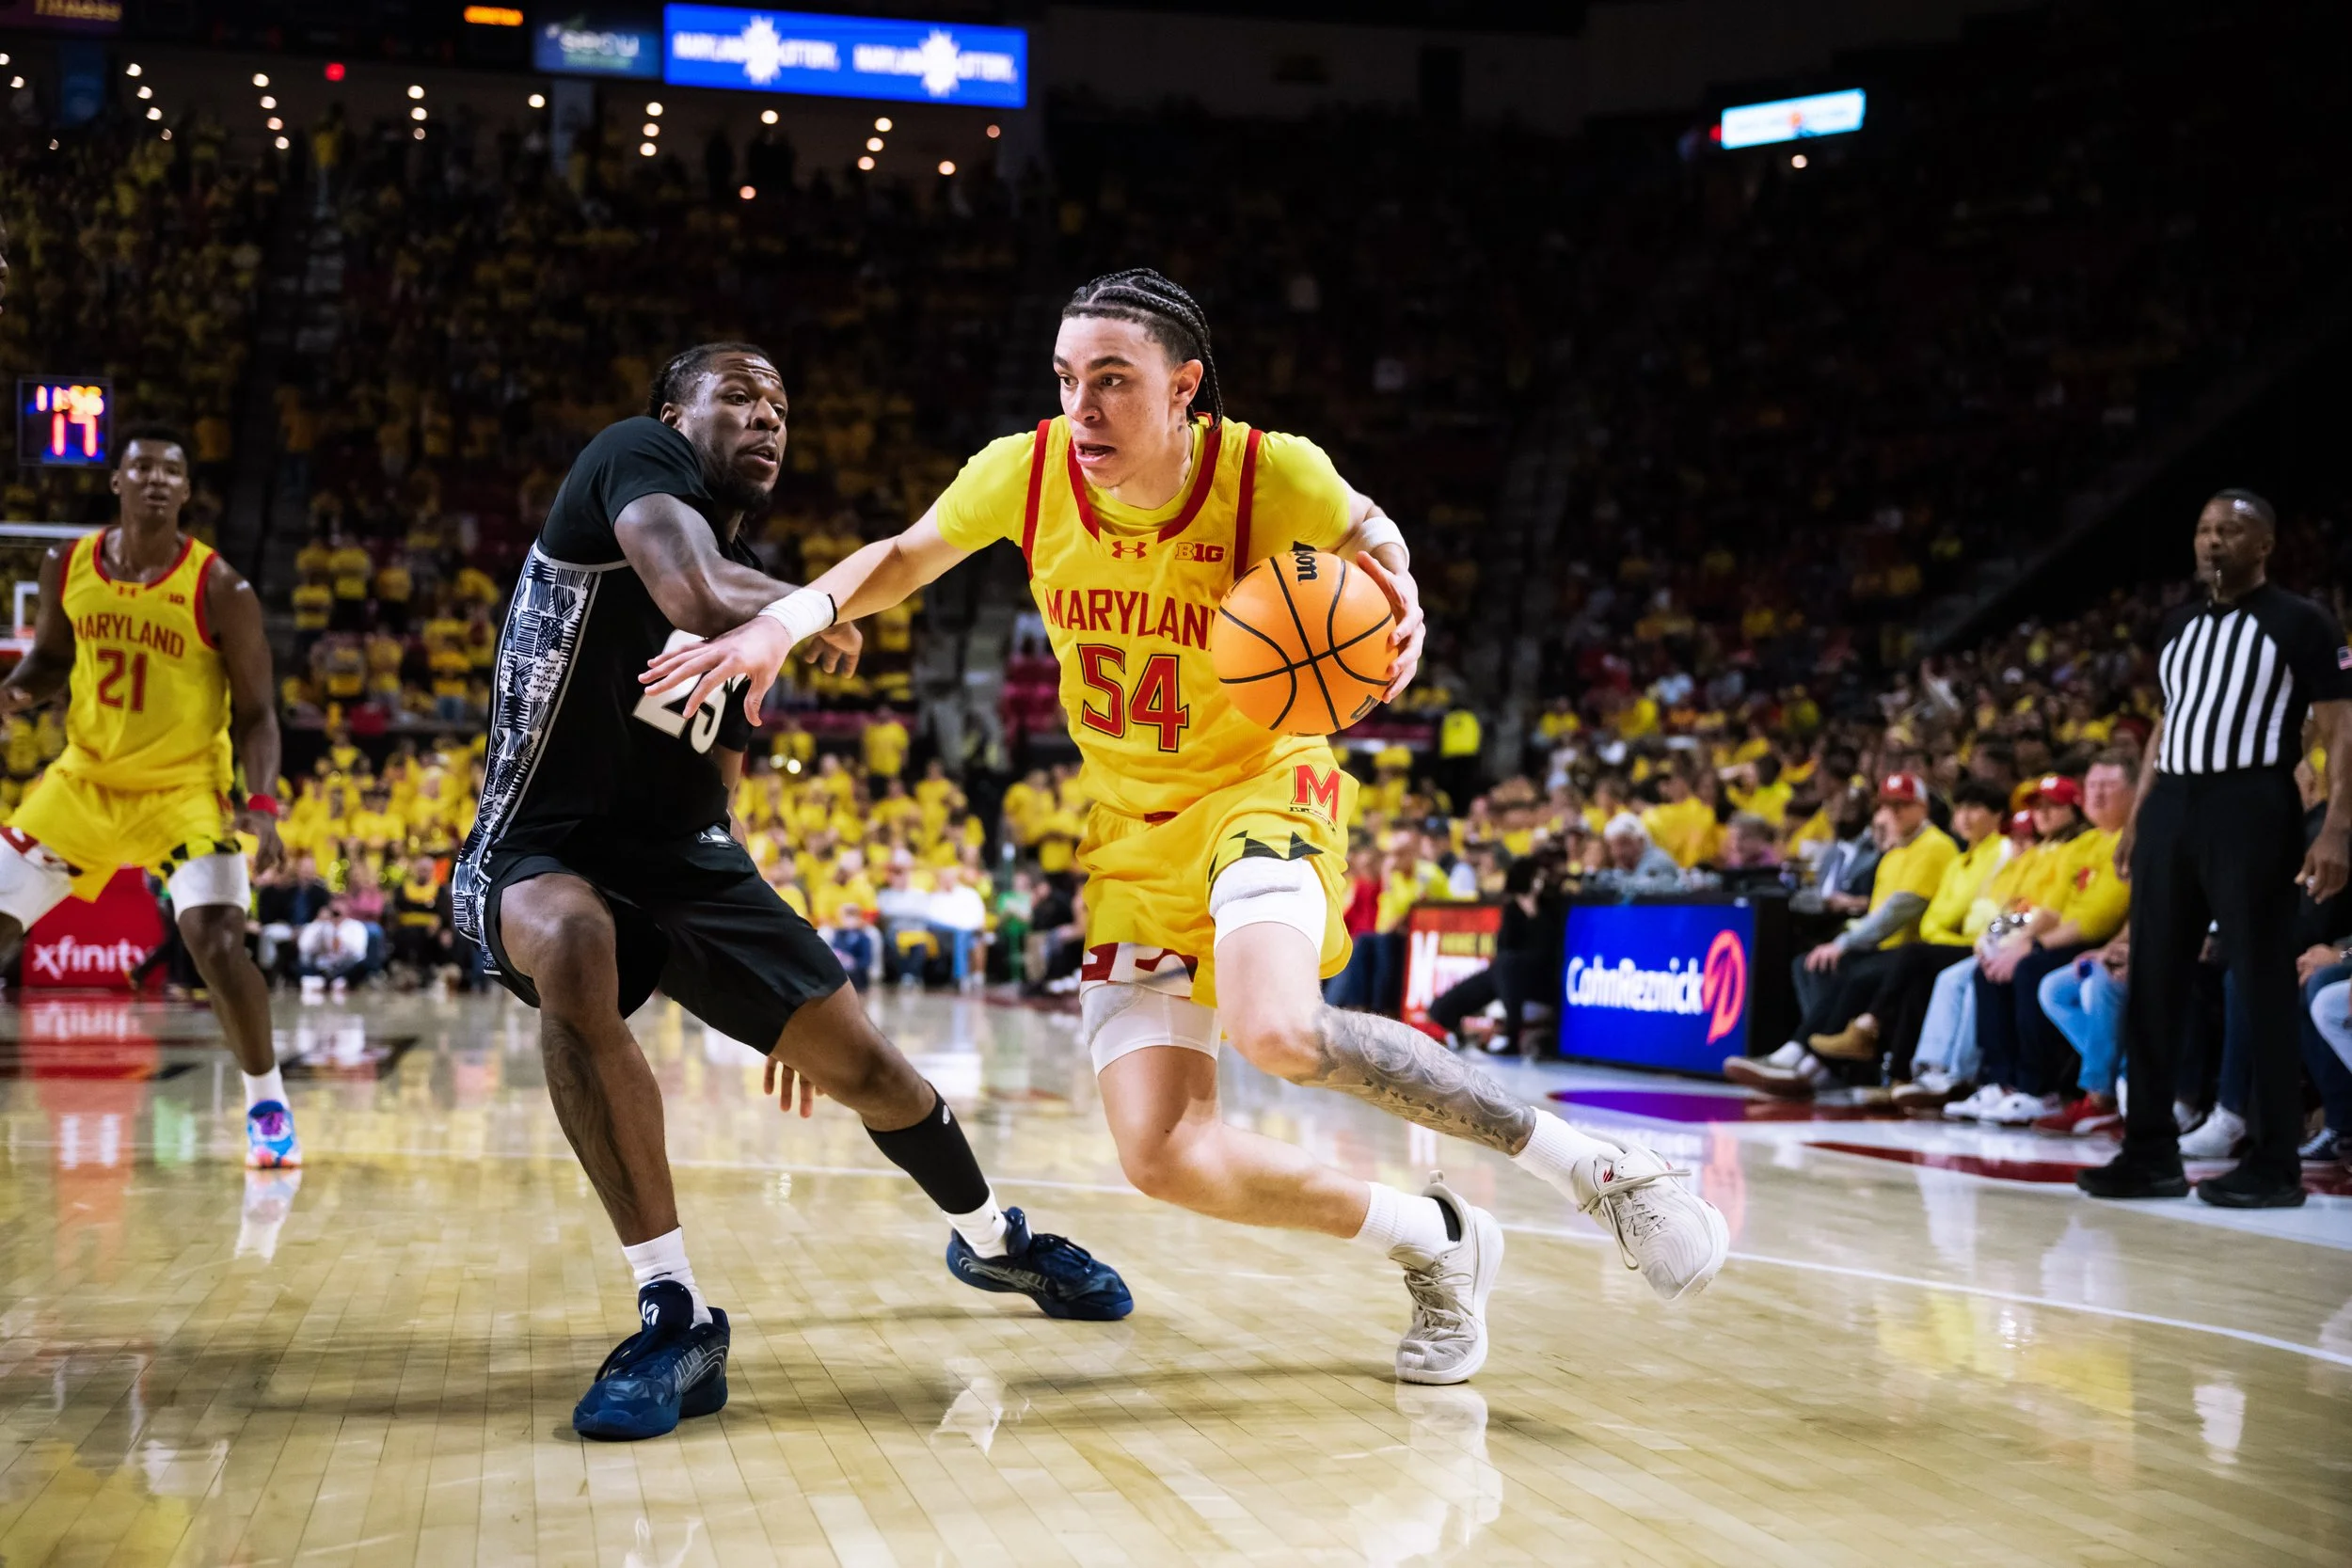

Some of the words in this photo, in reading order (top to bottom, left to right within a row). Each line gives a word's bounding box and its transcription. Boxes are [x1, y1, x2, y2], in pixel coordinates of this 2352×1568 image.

[1044, 588, 1217, 652] MARYLAN
[97, 647, 149, 714] 21
[1077, 643, 1190, 753] 54
[1290, 764, 1343, 828] M
